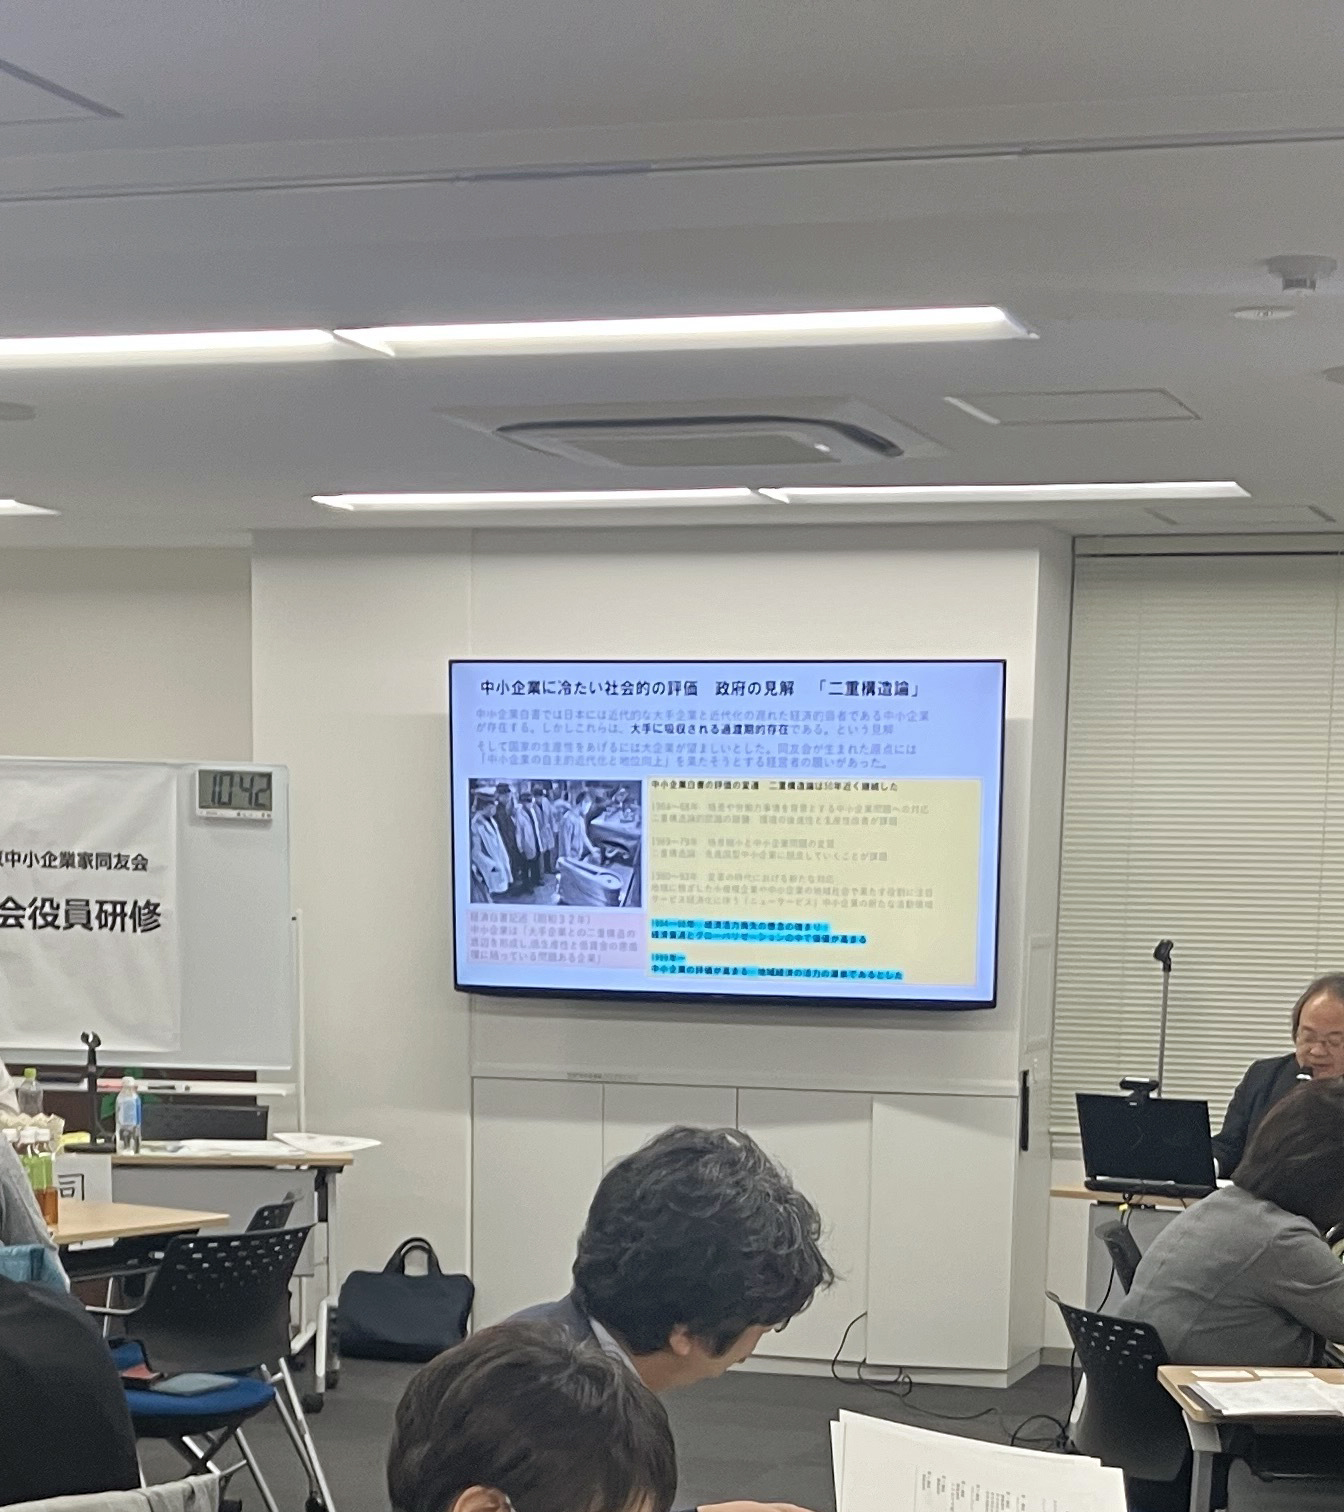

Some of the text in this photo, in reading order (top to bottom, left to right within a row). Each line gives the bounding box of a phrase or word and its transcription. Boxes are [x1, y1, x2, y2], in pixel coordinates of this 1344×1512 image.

[715, 680, 795, 697] 政府の見解
